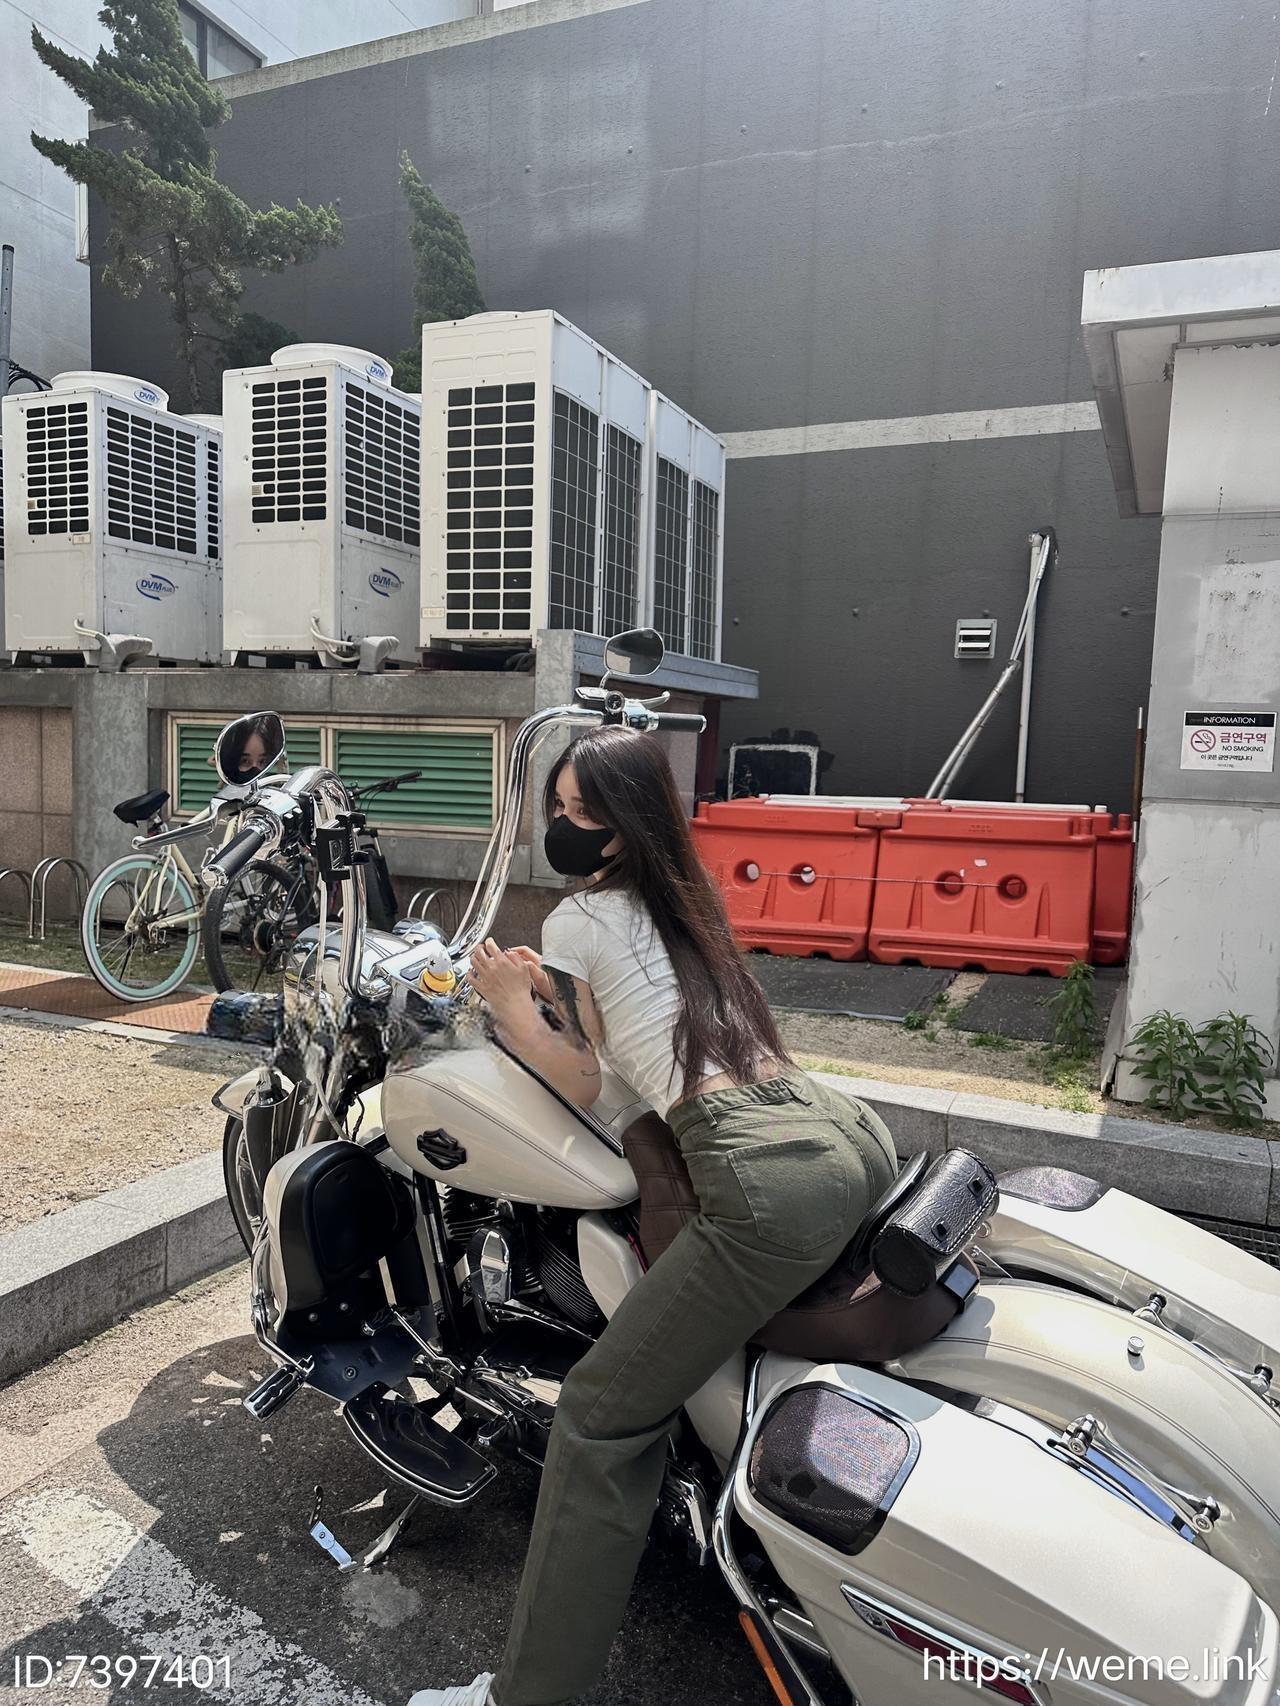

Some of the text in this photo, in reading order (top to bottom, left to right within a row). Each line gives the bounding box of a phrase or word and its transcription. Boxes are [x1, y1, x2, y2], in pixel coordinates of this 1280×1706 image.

[370, 366, 385, 377] DVM
[139, 391, 156, 402] DVM
[140, 579, 162, 591] DVM
[372, 574, 391, 586] DVM
[1203, 716, 1256, 724] INFORMATION
[1219, 732, 1267, 744] 금연구역
